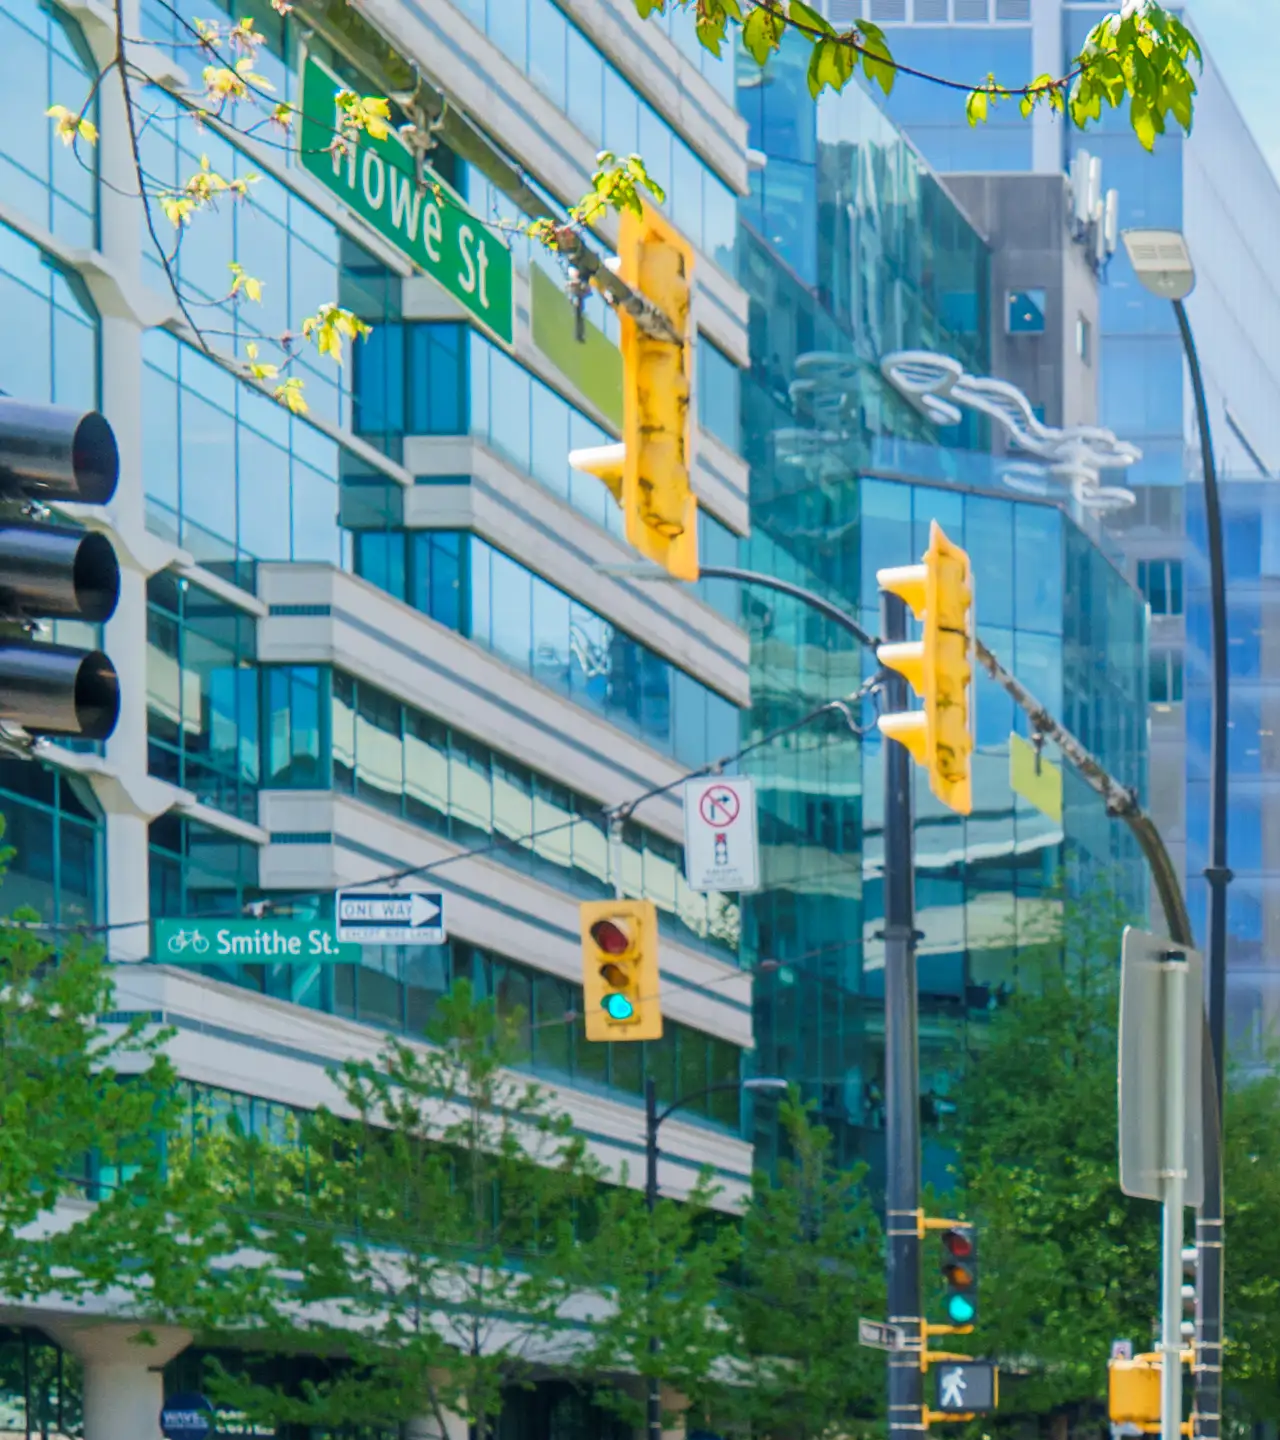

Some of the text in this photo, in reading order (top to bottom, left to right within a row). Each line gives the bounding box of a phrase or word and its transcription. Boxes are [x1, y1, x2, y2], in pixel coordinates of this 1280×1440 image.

[458, 224, 489, 309] St
[345, 904, 413, 917] ONE WAY
[216, 929, 340, 955] Smithe St.
